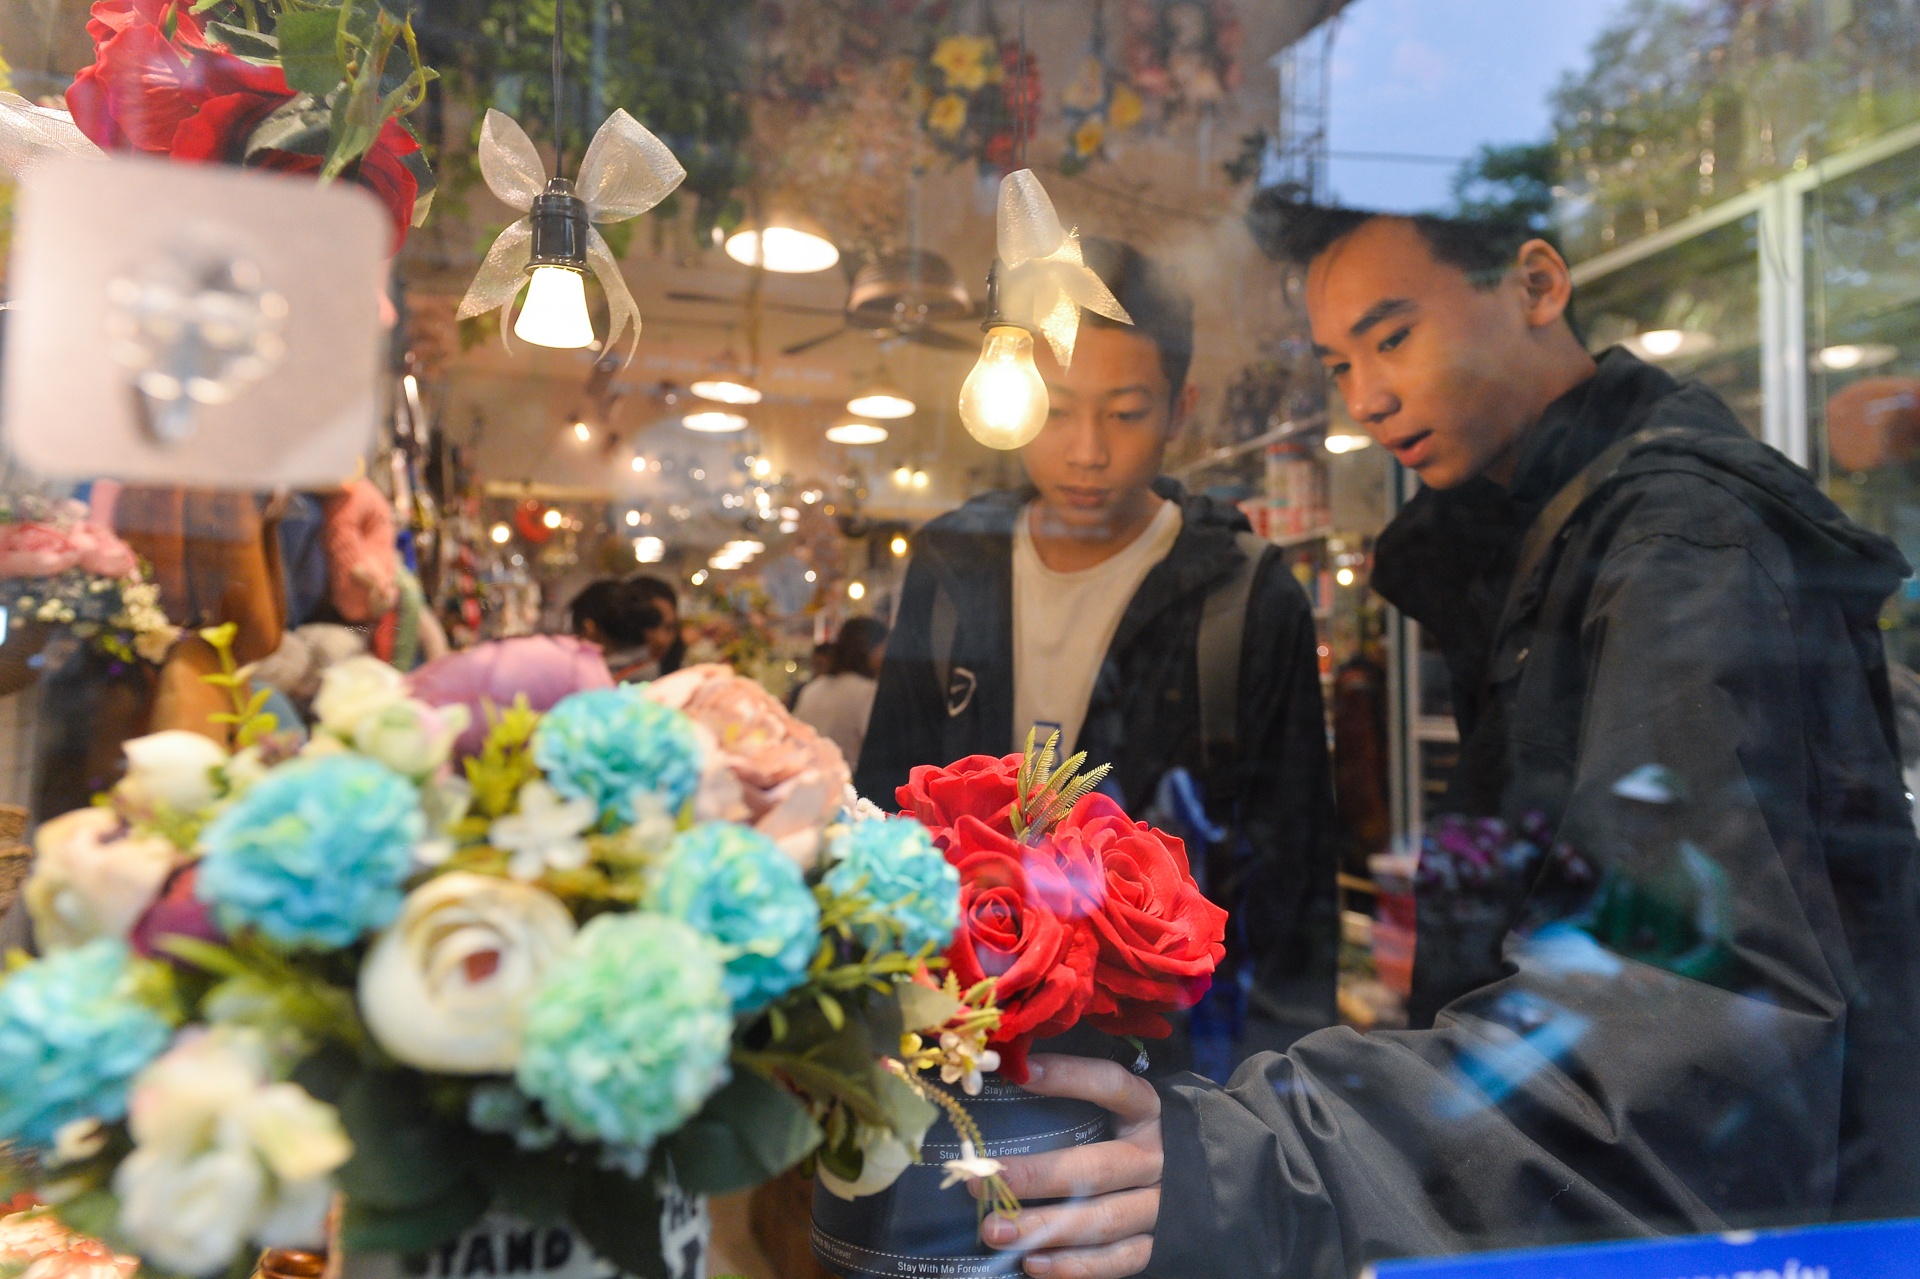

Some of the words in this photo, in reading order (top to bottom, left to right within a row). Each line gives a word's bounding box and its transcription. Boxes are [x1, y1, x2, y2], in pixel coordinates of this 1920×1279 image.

[984, 1085, 1003, 1096] Stay
[1075, 1130, 1088, 1141] Stay
[939, 1150, 960, 1161] Stay
[983, 1148, 998, 1158] Me
[1000, 1145, 1030, 1156] Forever
[897, 1261, 917, 1274] Stay
[918, 1263, 939, 1274] With
[941, 1264, 955, 1274] Me
[957, 1264, 990, 1273] Forever
